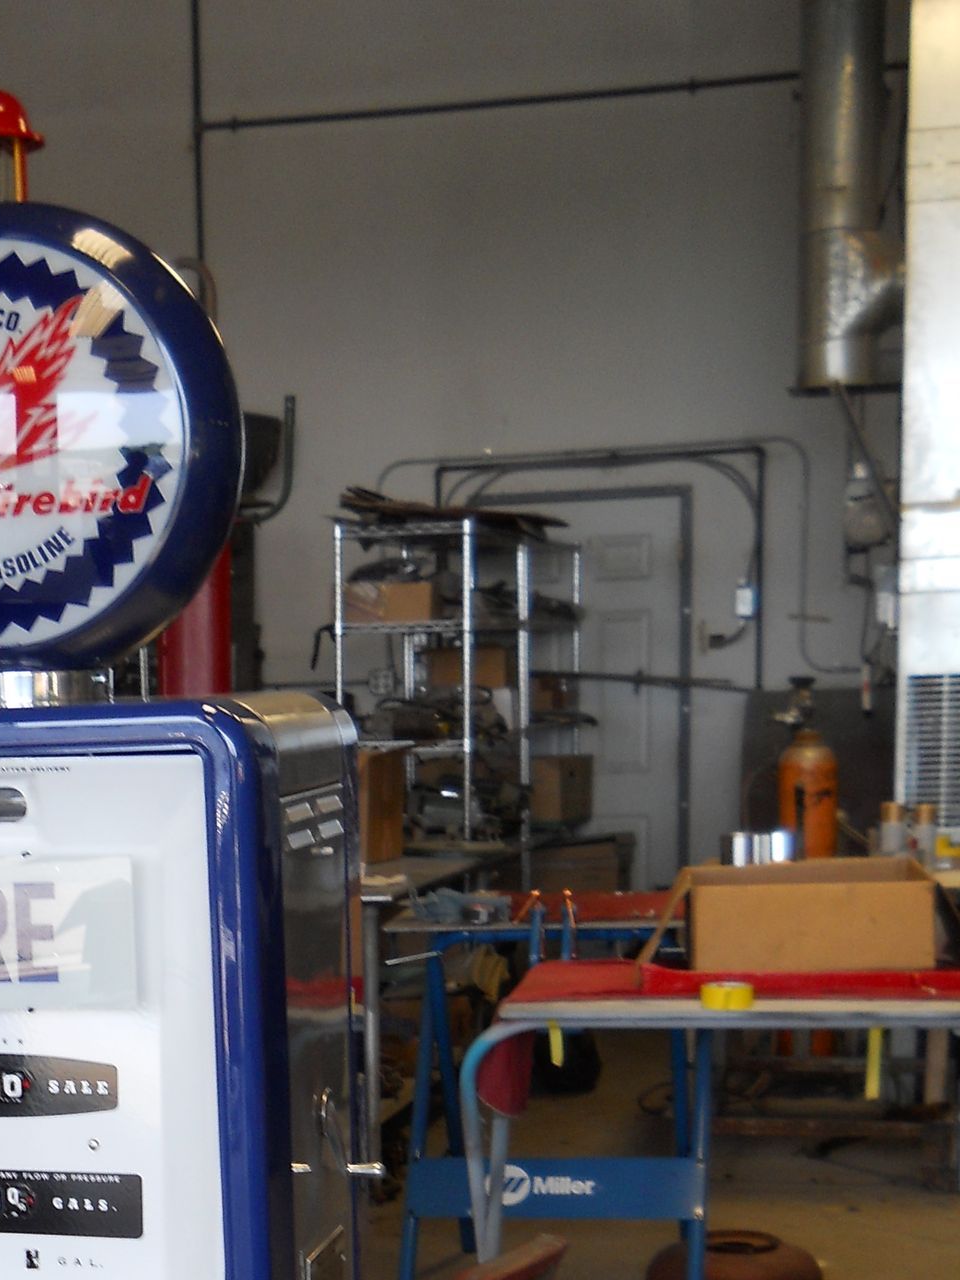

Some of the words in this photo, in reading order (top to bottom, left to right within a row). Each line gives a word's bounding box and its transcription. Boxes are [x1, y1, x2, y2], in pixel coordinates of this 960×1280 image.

[48, 1078, 110, 1097] SALE
[70, 1173, 121, 1184] PRESSURE
[532, 1176, 597, 1196] Miller
